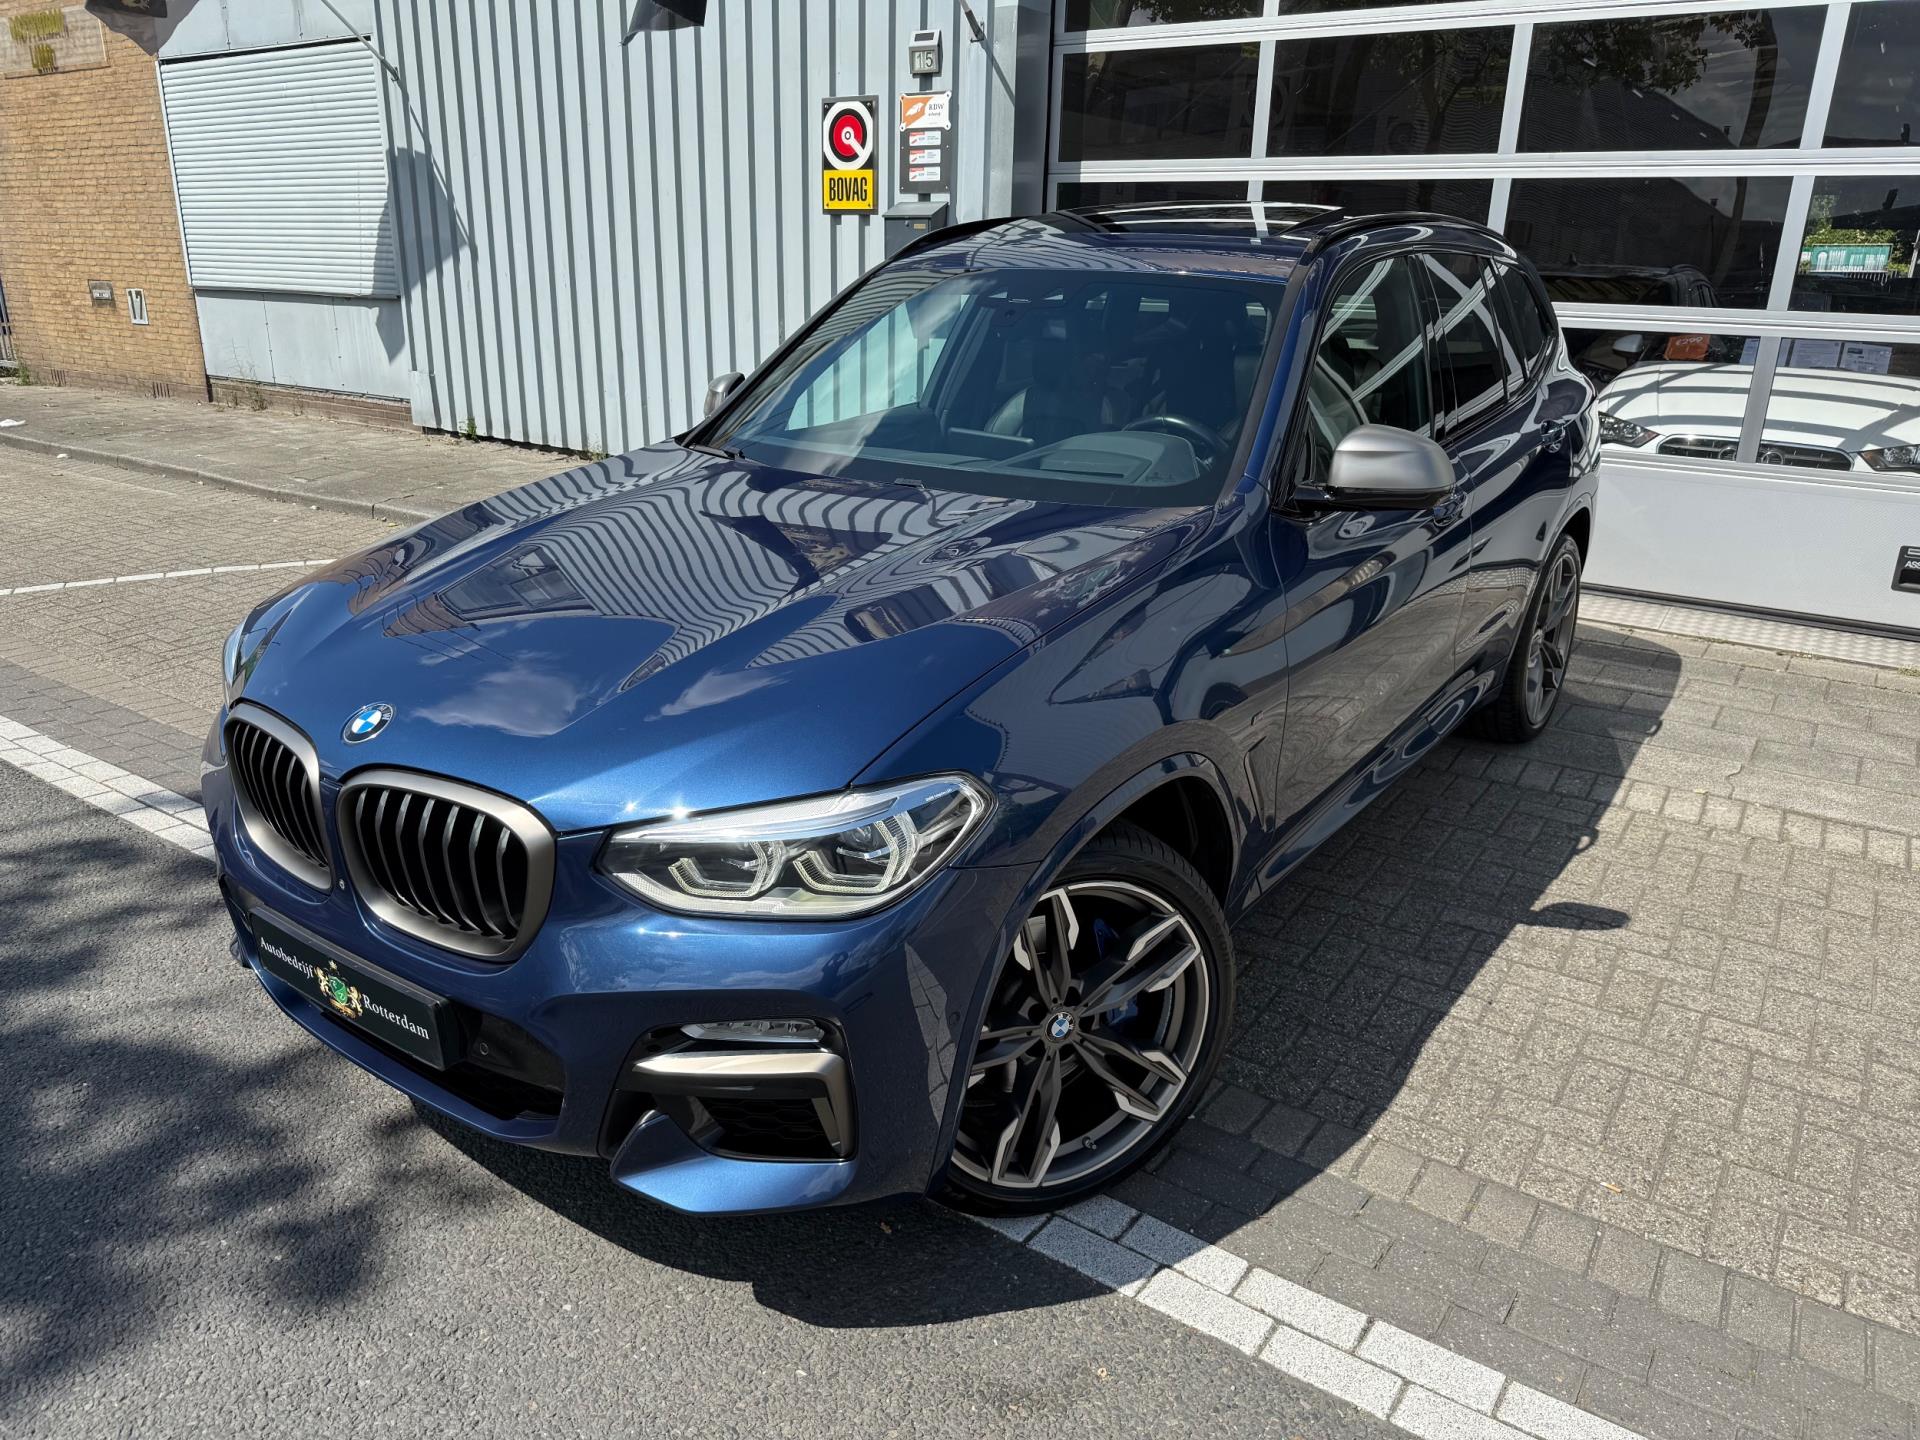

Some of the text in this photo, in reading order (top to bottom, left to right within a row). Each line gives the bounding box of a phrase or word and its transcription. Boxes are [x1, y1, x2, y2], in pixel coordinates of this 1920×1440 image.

[917, 51, 934, 69] 15
[829, 177, 868, 202] BOVAG
[128, 290, 143, 320] 17
[260, 937, 430, 1040] Autobedrijf Rotterdam
